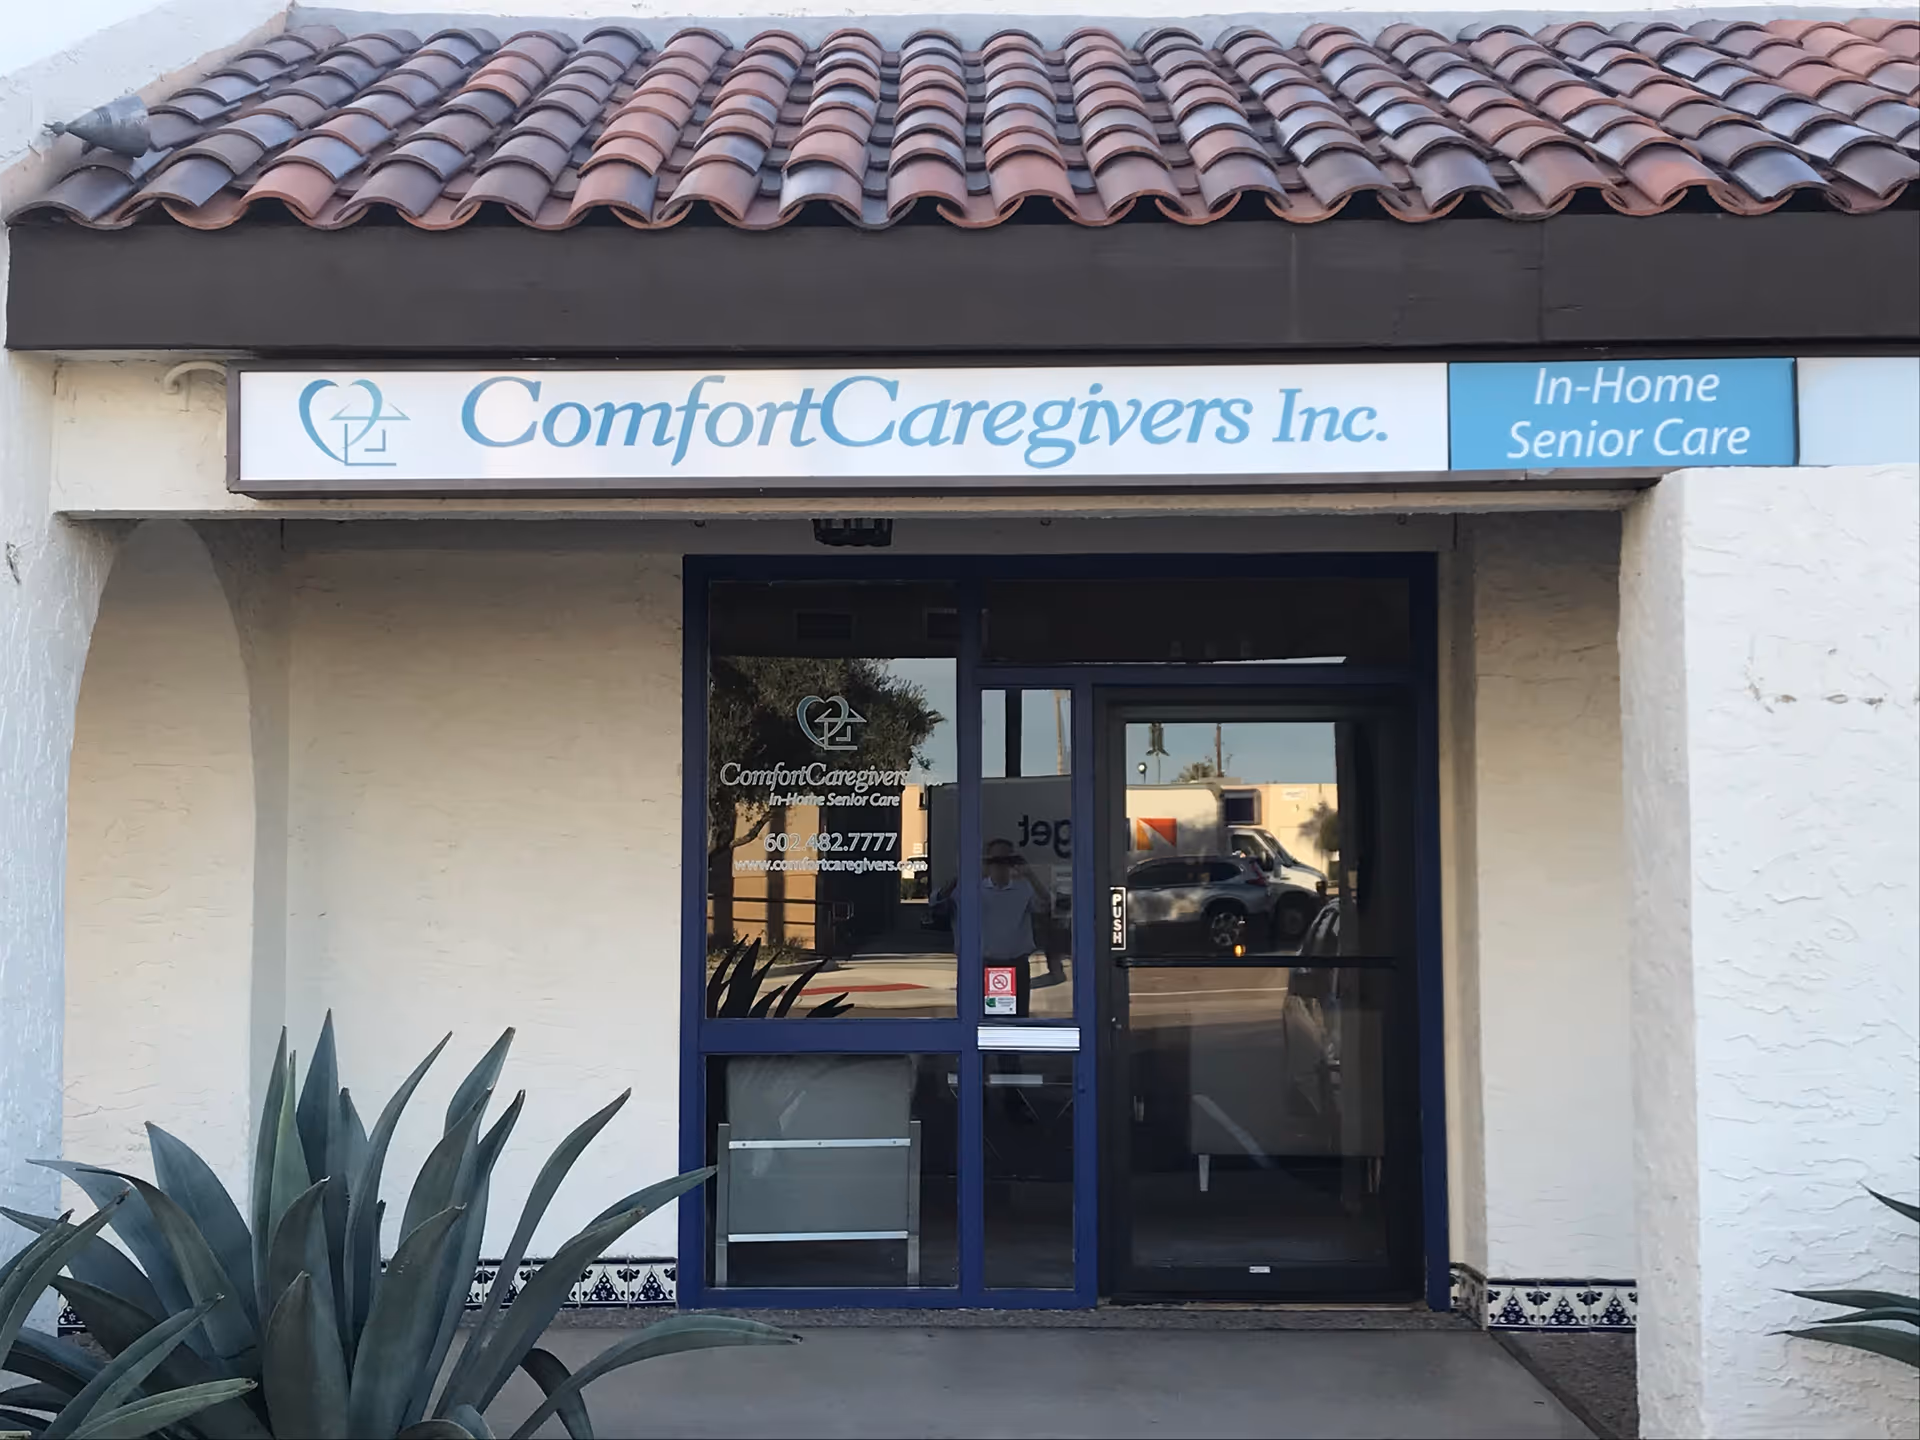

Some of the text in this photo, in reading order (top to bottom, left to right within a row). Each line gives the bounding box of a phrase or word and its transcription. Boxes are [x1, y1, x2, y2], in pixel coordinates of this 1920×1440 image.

[1534, 366, 1721, 406] In-Home
[461, 374, 1389, 470] ComfortCaregivers Inc.
[1506, 417, 1752, 460] Senior Care
[769, 792, 900, 807] In-Home Senior Care
[764, 832, 898, 852] 602.482.7777
[733, 856, 929, 874] www.comfortcaregivers.com
[1112, 893, 1122, 944] PUSH
